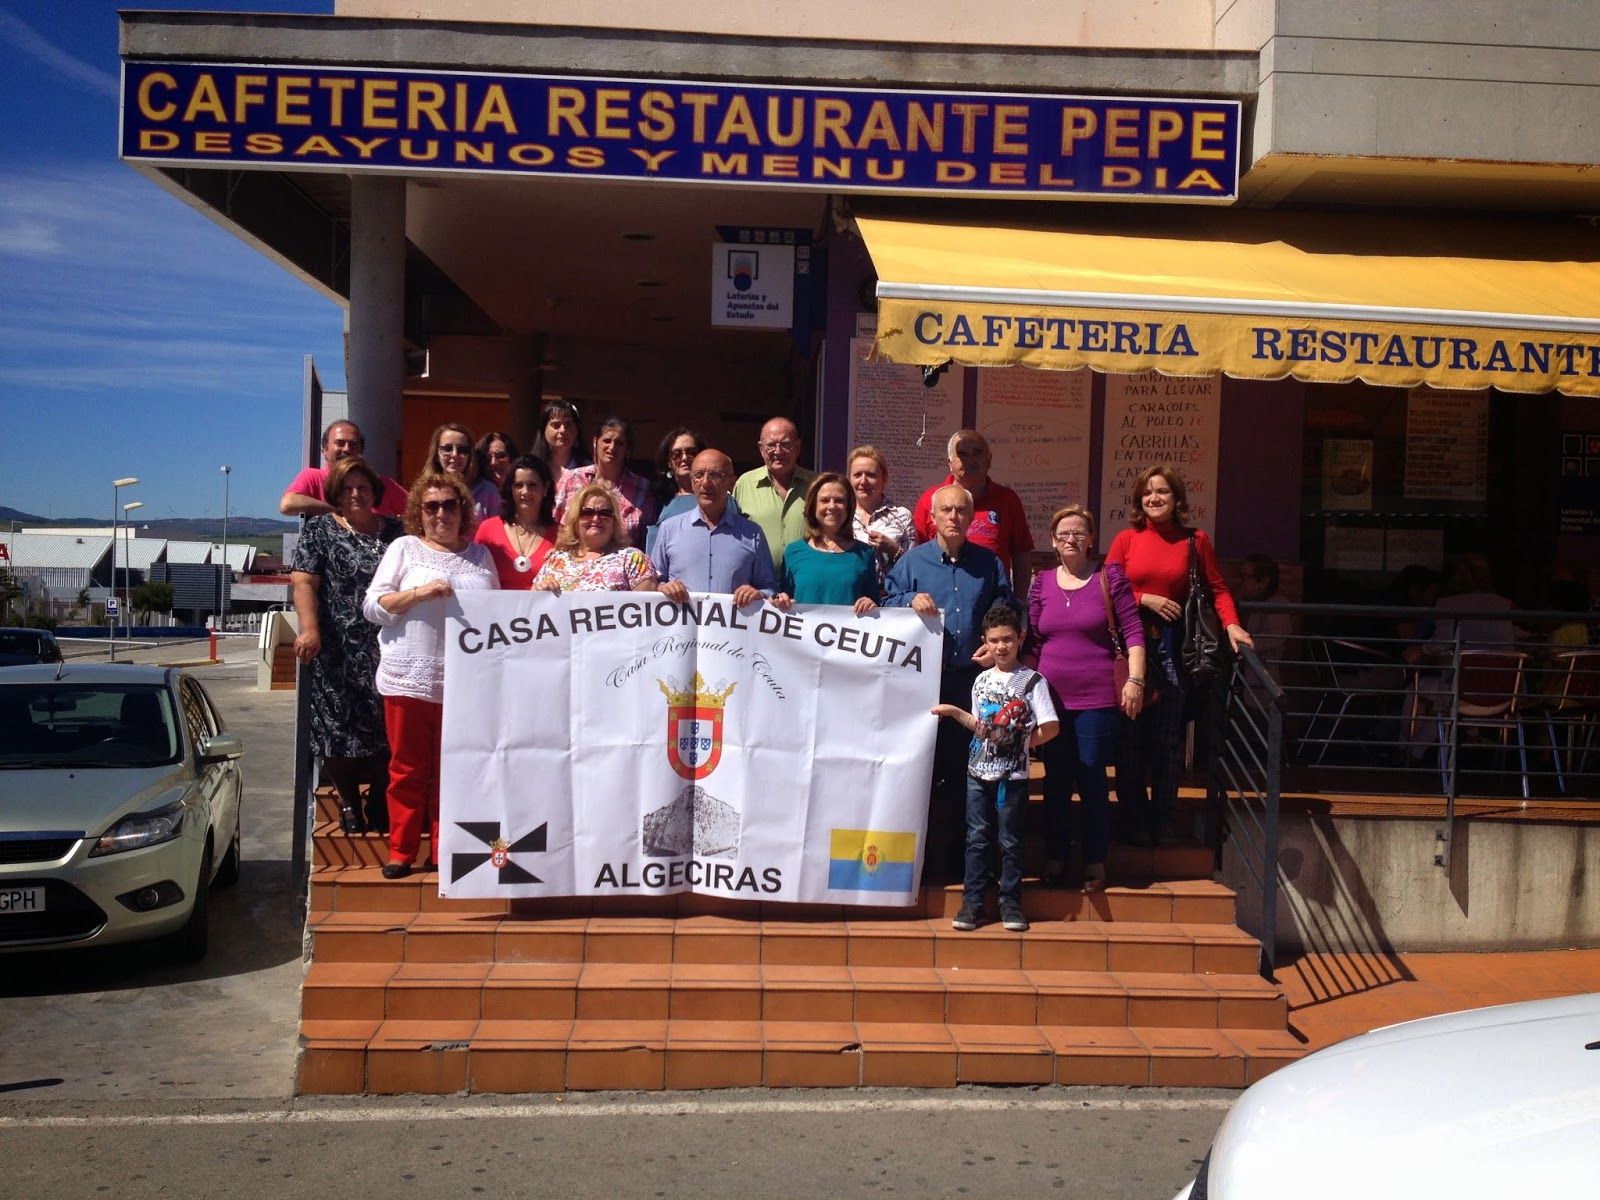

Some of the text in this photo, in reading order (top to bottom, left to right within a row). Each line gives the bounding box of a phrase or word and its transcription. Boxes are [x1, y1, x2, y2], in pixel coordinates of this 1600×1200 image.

[136, 70, 1228, 163] CAFETERIA RESTAURANTE PEPE
[138, 129, 1226, 192] DESAYUNOS Y MENU DEL DIA
[762, 294, 767, 302] y
[727, 302, 764, 310] Apuestas
[914, 311, 1199, 357] CAFETERIA
[1123, 384, 1212, 395] PARA LLEVAR
[1128, 402, 1200, 413] CARACOLES
[1121, 416, 1137, 428] AL
[1143, 416, 1184, 427] POLEO
[1009, 424, 1044, 433] OFERTA
[1114, 451, 1134, 461] EN
[1138, 450, 1188, 462] TOMATE
[1110, 481, 1125, 489] EN
[1109, 510, 1125, 520] EN
[458, 600, 924, 673] CASA REGIONAL DE CEUTA
[605, 633, 787, 701] Casa Regional de Ceuta
[593, 860, 782, 893] ALGECIRAS
[0, 890, 35, 910] GPH
